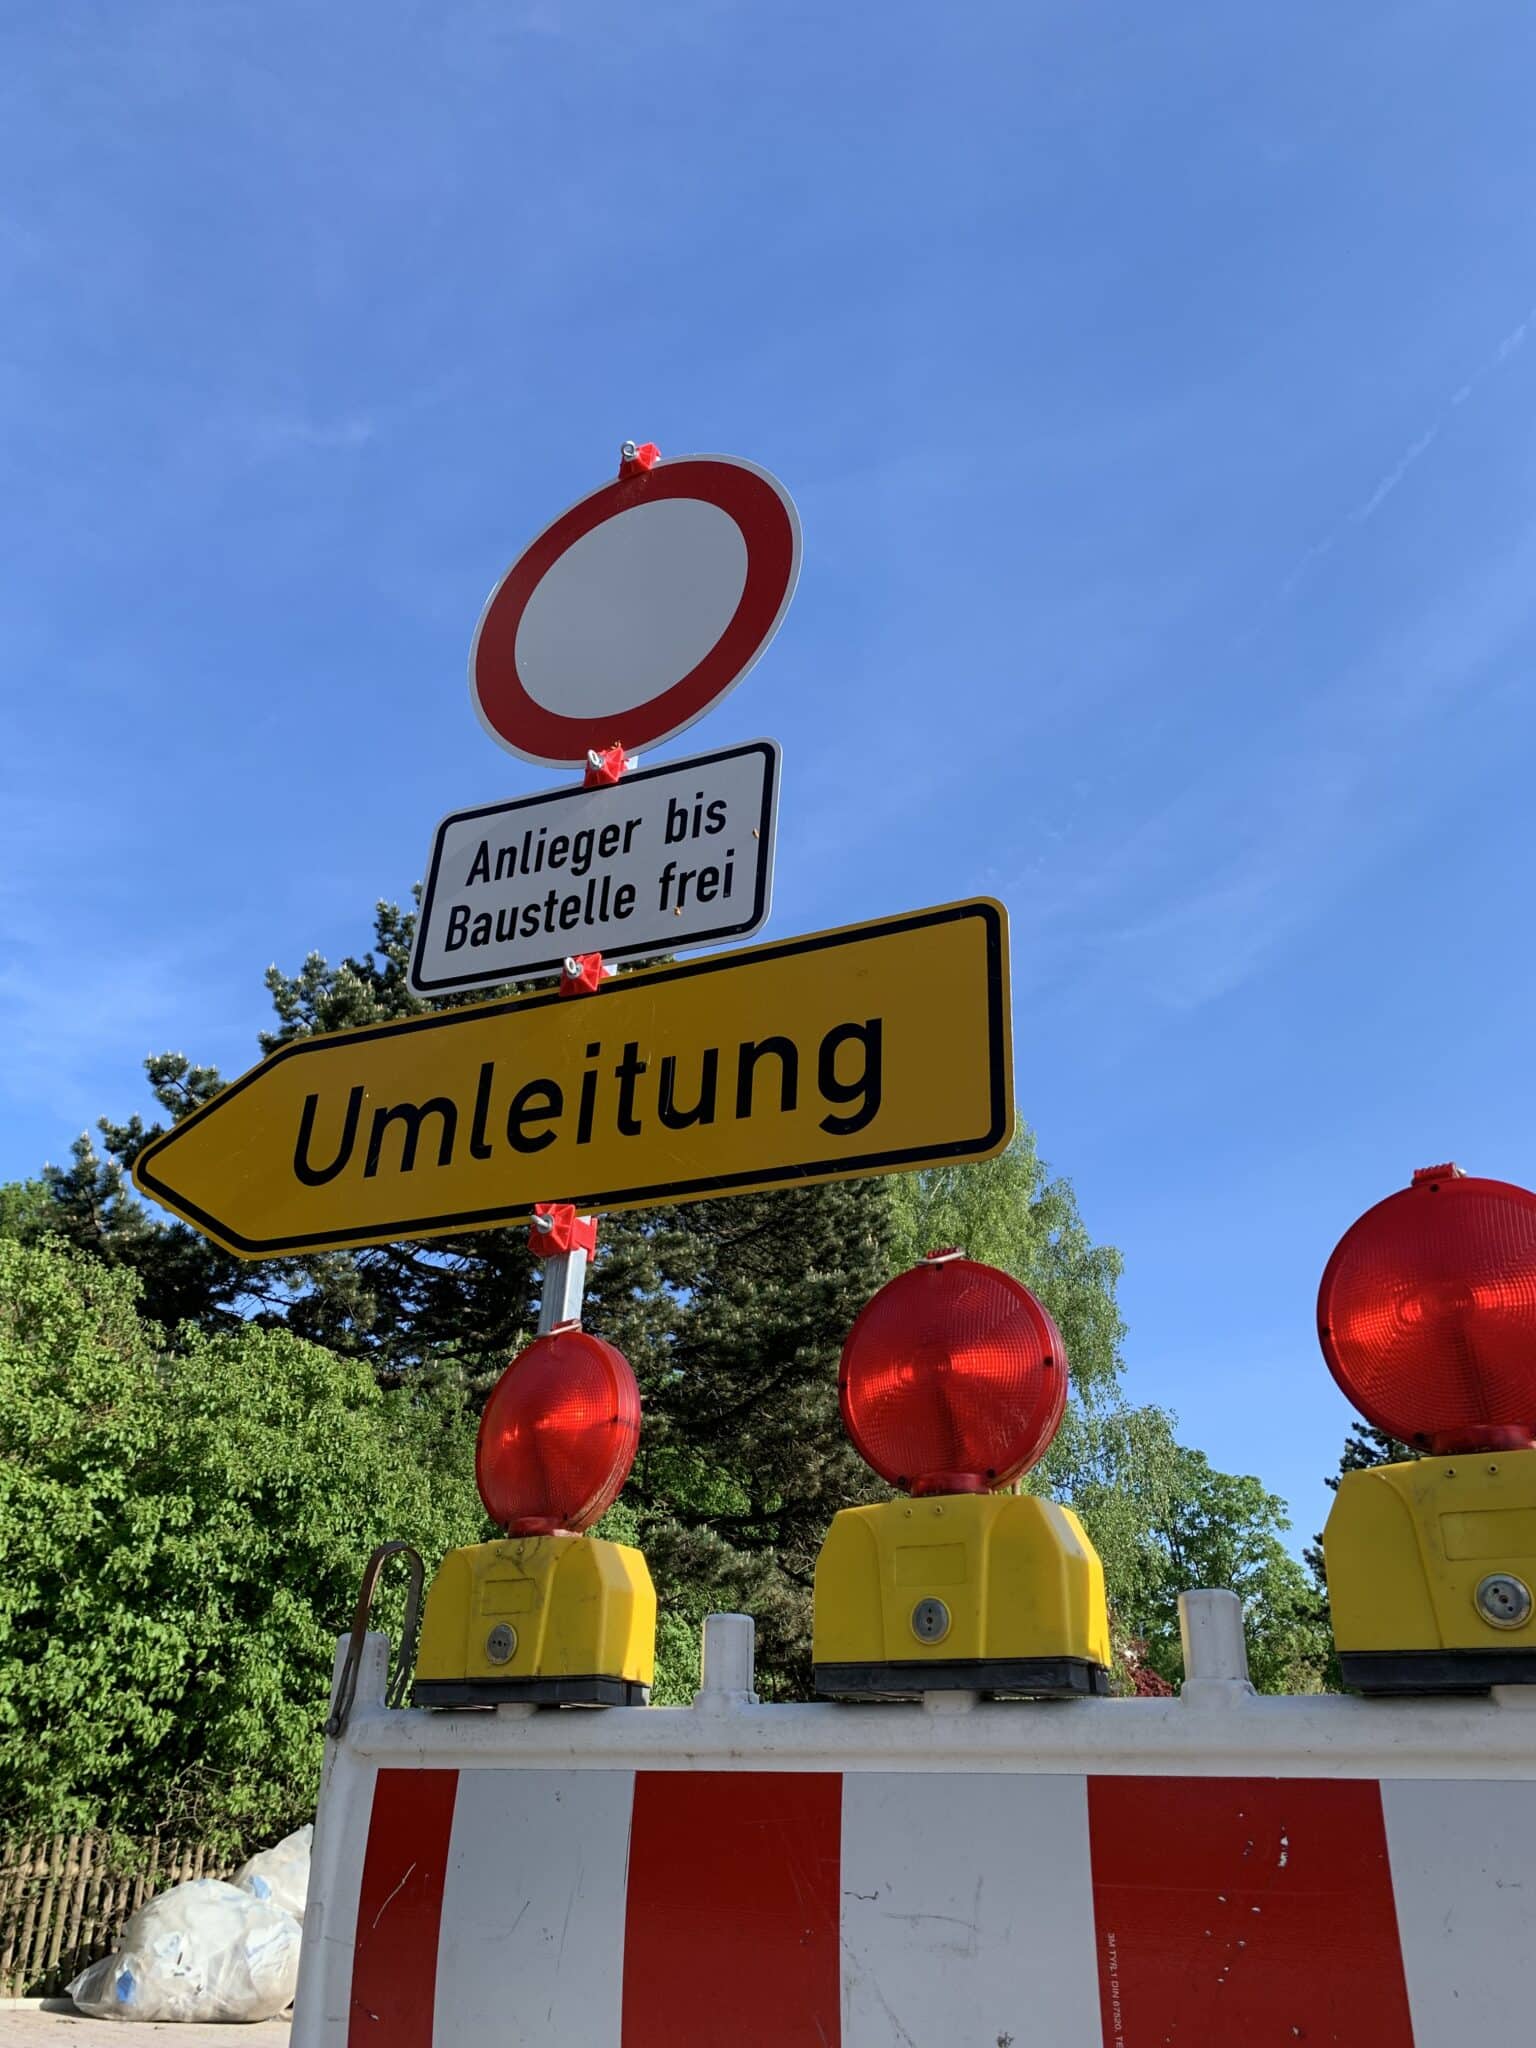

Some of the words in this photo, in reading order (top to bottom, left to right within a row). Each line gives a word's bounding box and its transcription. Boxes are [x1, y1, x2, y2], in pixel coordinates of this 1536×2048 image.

[465, 817, 642, 887] Anlieger
[664, 791, 728, 845] bis
[444, 875, 637, 952] Baustelle
[658, 848, 735, 912] frei
[293, 1017, 884, 1187] Umleitung
[1107, 1932, 1116, 1947] 3M
[1111, 1980, 1120, 1999] DIN
